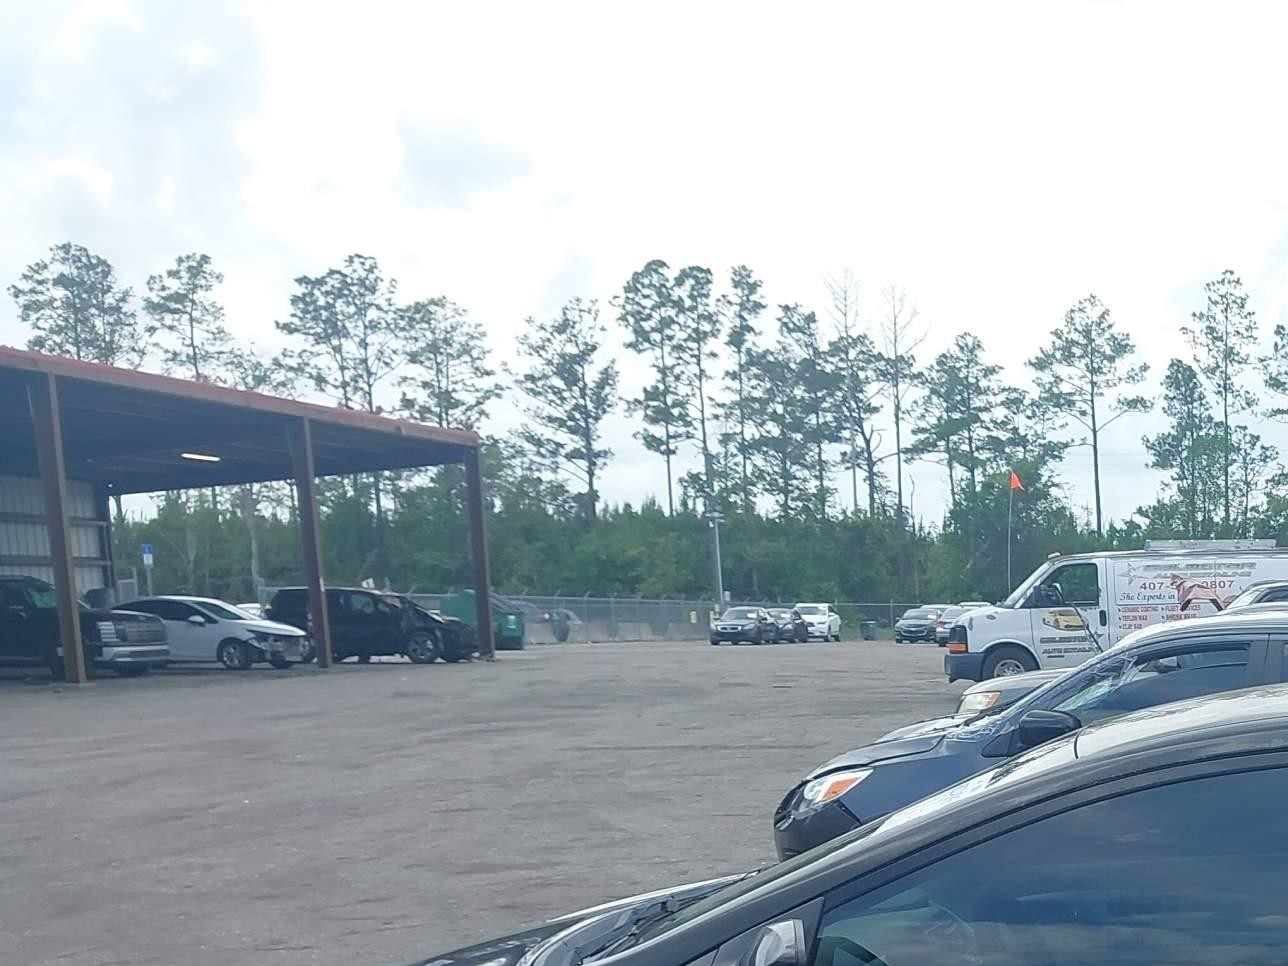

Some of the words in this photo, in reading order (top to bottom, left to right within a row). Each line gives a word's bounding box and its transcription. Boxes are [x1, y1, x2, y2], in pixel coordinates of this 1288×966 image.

[1119, 592, 1135, 601] The
[1137, 591, 1166, 602] Experts
[1168, 592, 1175, 600] in
